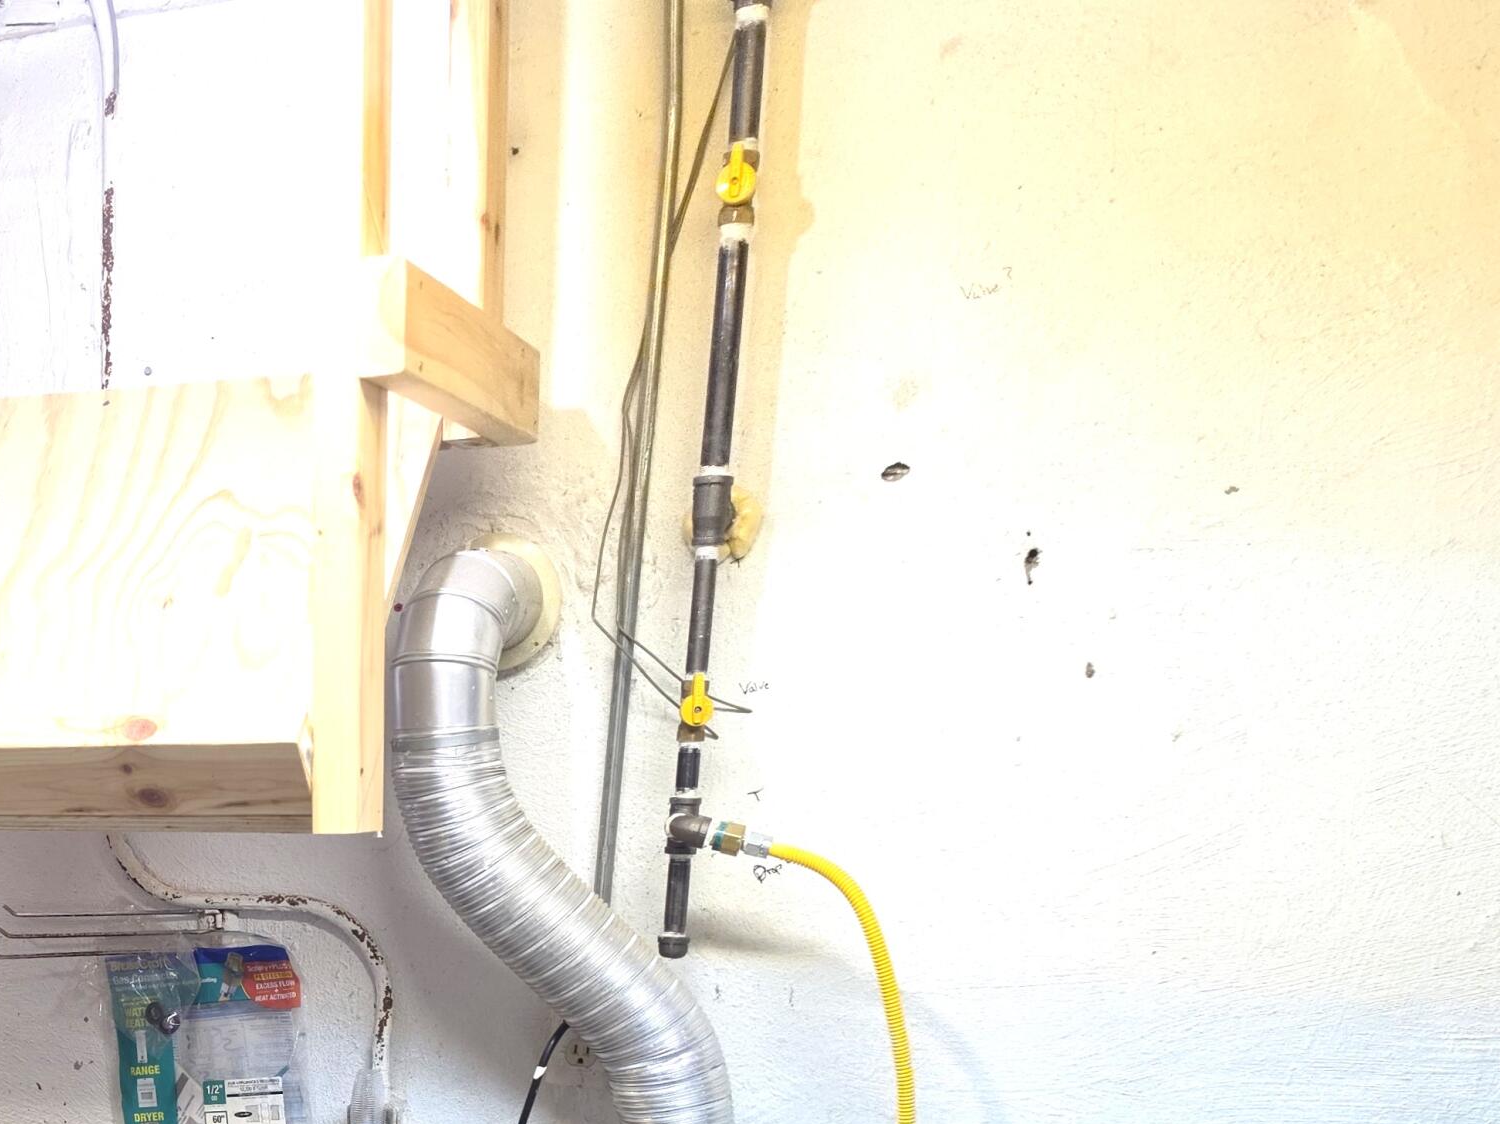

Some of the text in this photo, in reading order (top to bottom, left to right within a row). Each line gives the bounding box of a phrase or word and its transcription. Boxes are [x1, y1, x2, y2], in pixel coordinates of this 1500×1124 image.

[738, 680, 770, 695] Valve
[255, 980, 296, 990] EXCESS FLOW
[130, 1065, 161, 1076] RANGE
[206, 1084, 223, 1095] 1/2"
[134, 1111, 165, 1122] DRYER
[212, 1114, 225, 1124] 60"
